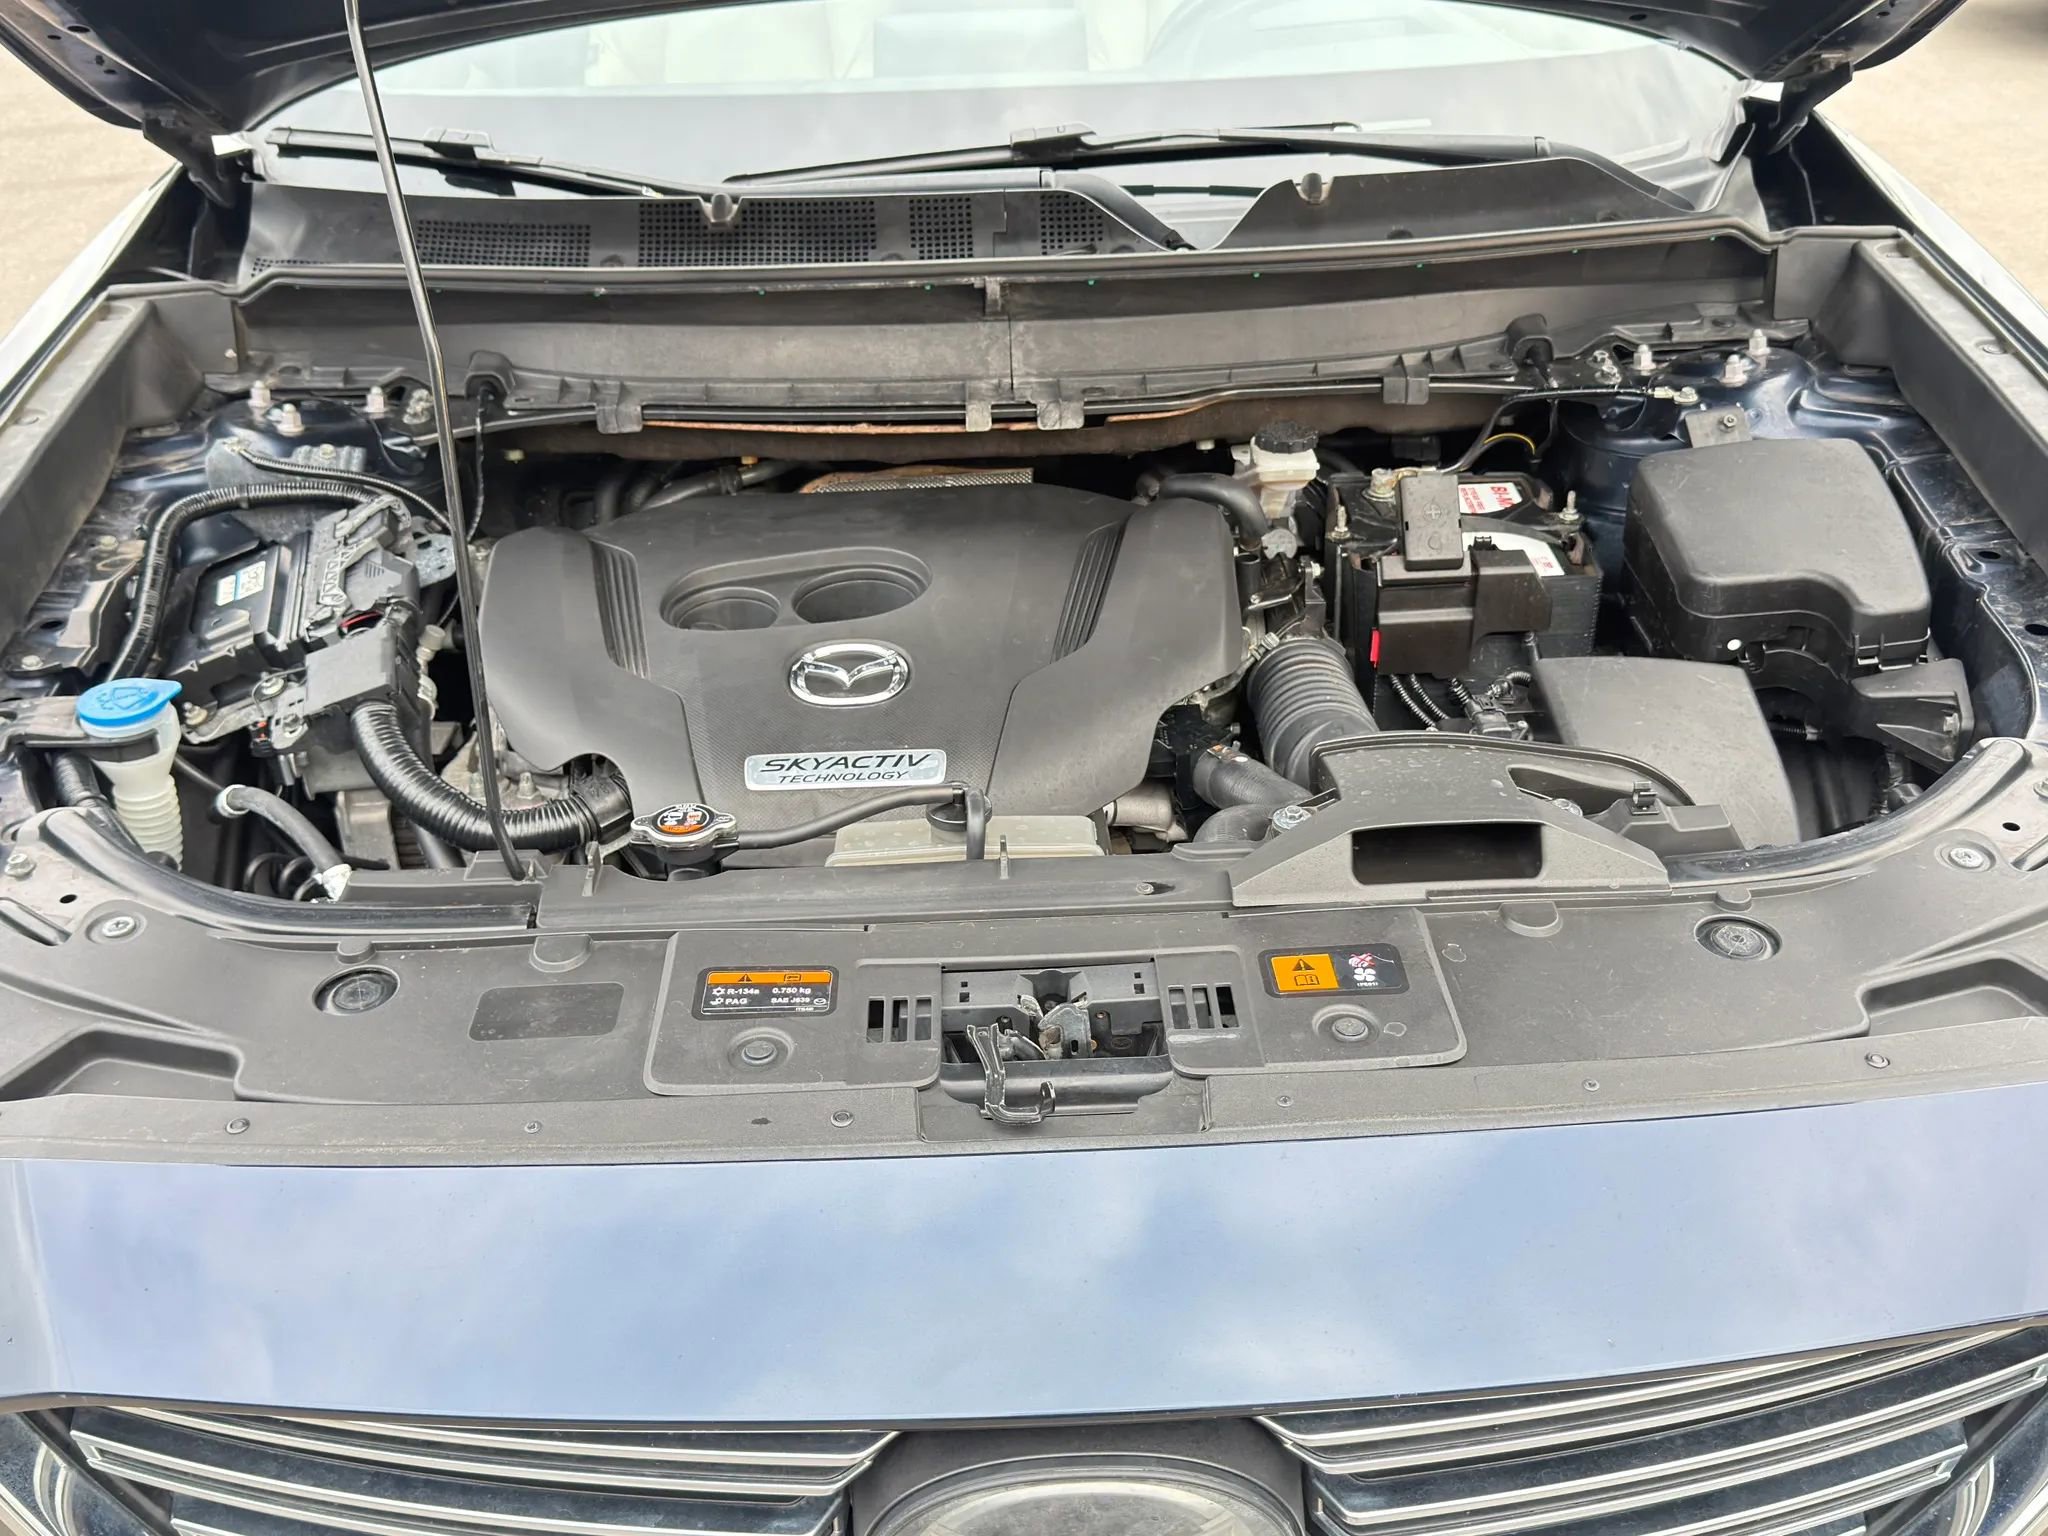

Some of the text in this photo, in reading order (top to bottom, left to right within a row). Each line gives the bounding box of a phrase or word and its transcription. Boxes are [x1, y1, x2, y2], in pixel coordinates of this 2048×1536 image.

[759, 753, 931, 773] SKYACTIV
[778, 770, 910, 784] TECHNOLOGY
[726, 987, 760, 995] R-134a
[799, 986, 812, 995] kg
[725, 997, 748, 1005] PAG
